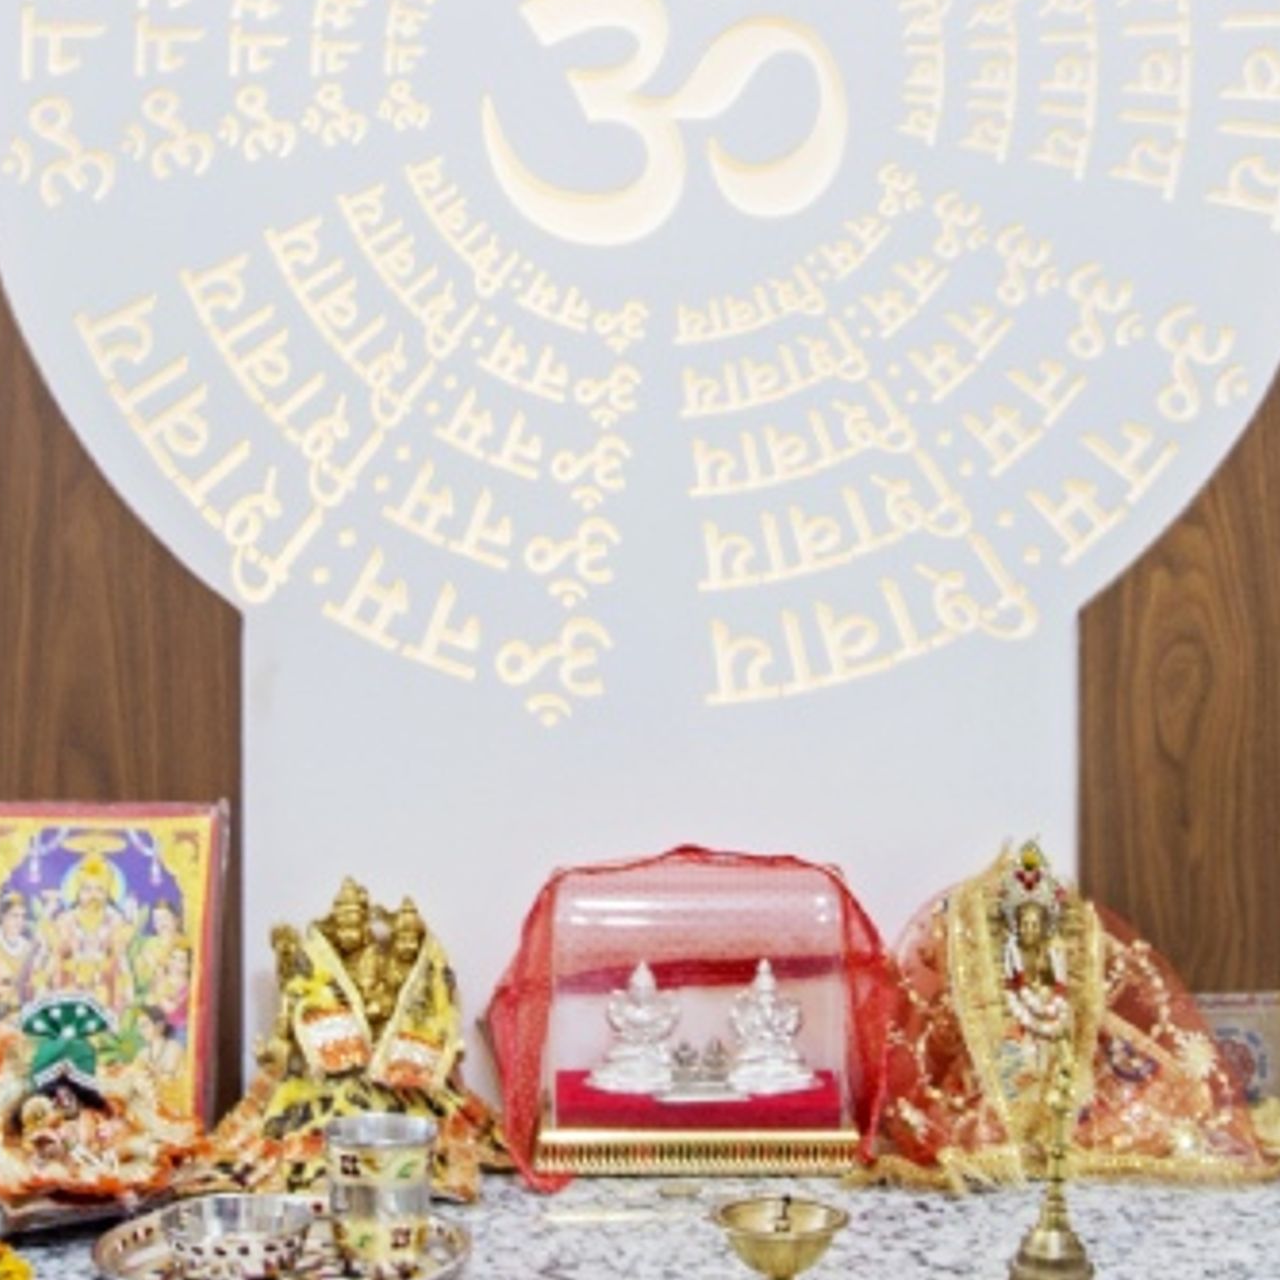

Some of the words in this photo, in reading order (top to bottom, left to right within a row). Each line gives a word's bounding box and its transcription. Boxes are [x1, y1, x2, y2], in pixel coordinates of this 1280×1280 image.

[262, 214, 434, 426] शिवाय
[333, 182, 478, 358] शिवाय
[70, 291, 329, 603] शिवाय
[176, 251, 394, 507] शिवाय
[680, 321, 869, 417] शिवाय
[684, 380, 918, 498] शिवाय
[695, 431, 974, 596] शिवाय
[696, 519, 1040, 709] शिवाय
